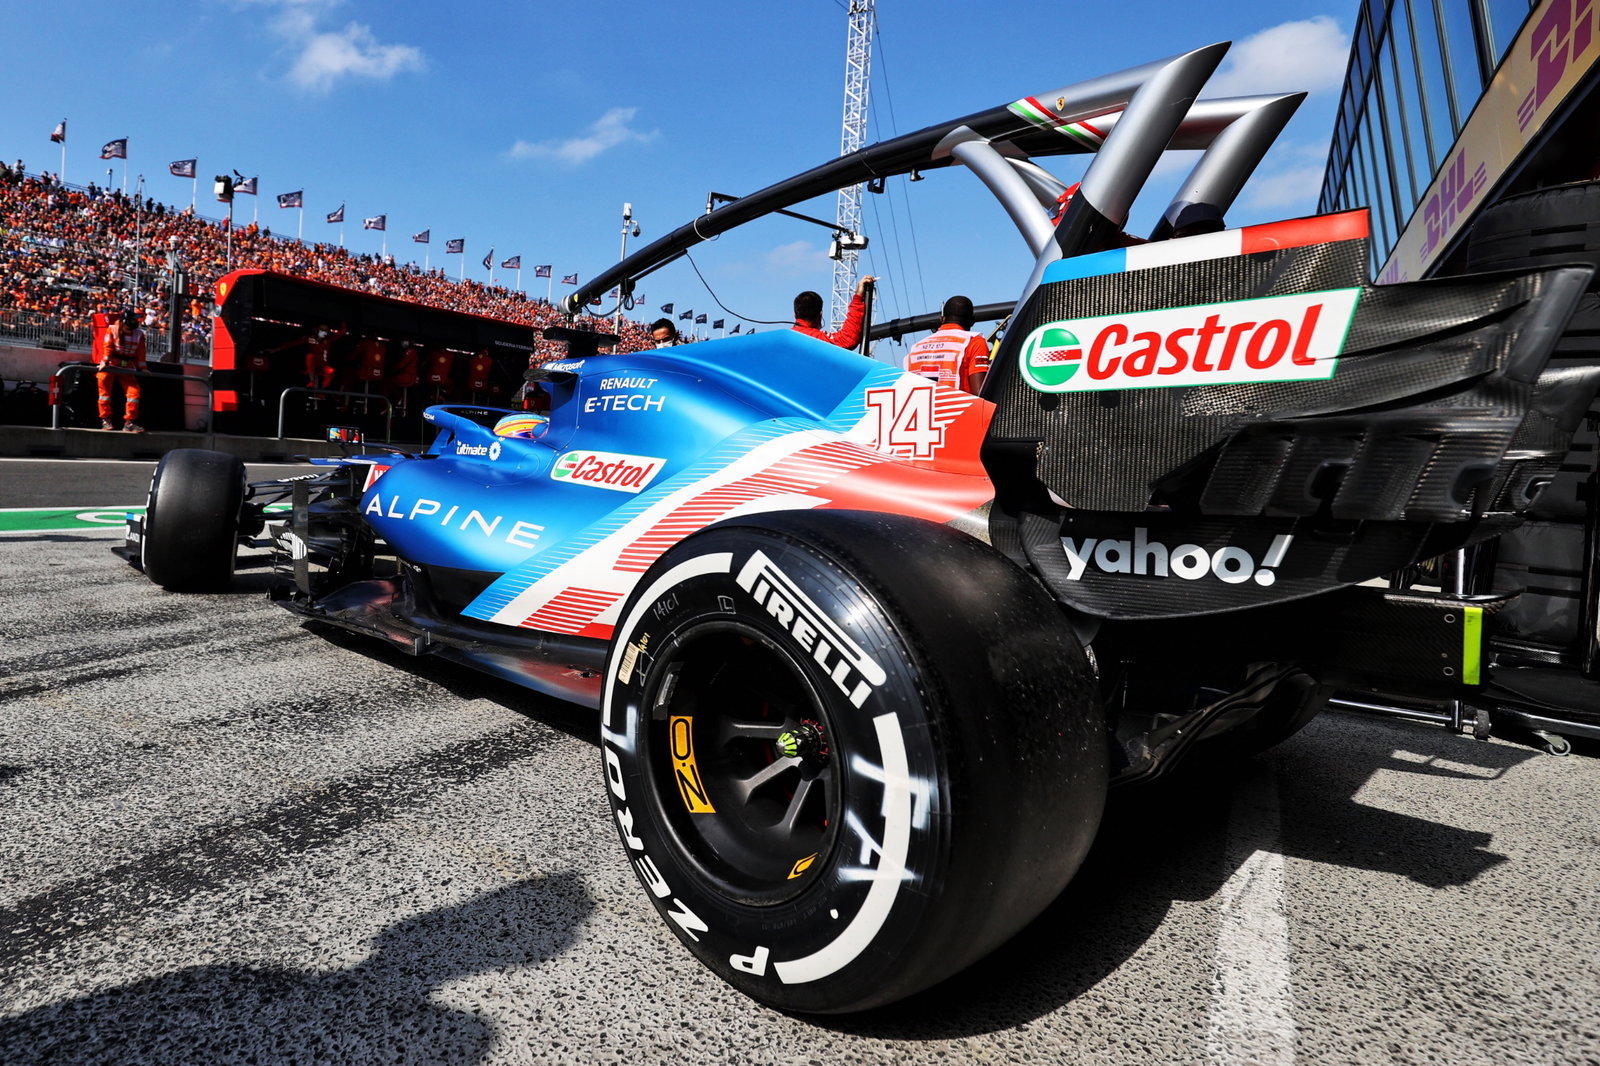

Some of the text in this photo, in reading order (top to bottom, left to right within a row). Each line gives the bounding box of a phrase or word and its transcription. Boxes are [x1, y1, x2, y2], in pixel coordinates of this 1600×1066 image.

[1423, 147, 1475, 255] DHL
[553, 359, 585, 372] Microsoft
[1087, 303, 1324, 381] Castrol
[584, 394, 667, 413] E-TECH
[599, 377, 658, 391] RENAULT
[456, 443, 489, 456] ultimate
[865, 386, 945, 460] 14
[571, 455, 655, 488] Castrol
[365, 493, 546, 549] ALPINE
[1060, 527, 1296, 588] yahoo!
[735, 549, 888, 710] PIRELLI
[604, 745, 770, 977] P ZERO
